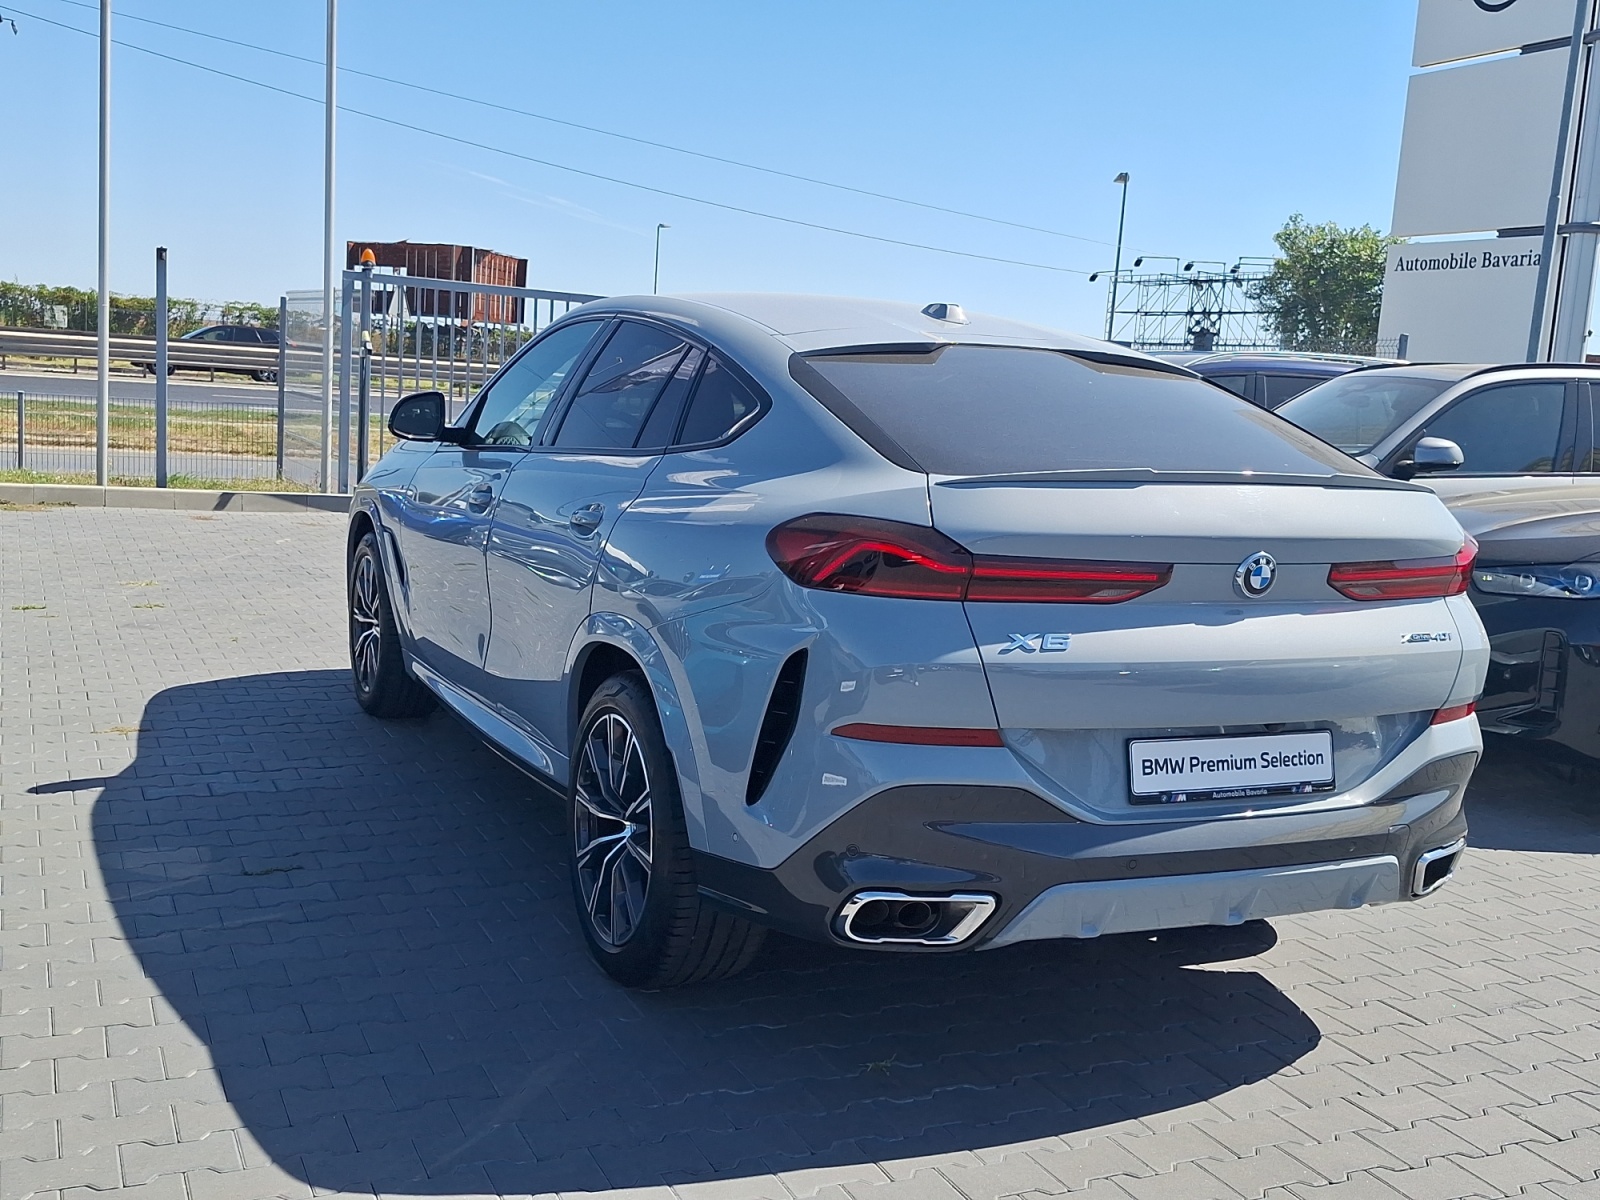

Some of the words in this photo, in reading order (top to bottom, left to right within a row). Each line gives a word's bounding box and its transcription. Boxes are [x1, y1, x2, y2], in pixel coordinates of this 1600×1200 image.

[1394, 252, 1477, 272] Automobile
[1480, 249, 1541, 268] Bavaria
[998, 632, 1072, 655] X6
[1141, 757, 1186, 776] BMW
[1189, 754, 1257, 774] Premium
[1260, 750, 1324, 769] Selection
[1212, 790, 1245, 799] Automobile
[1246, 788, 1268, 796] Bavaria
